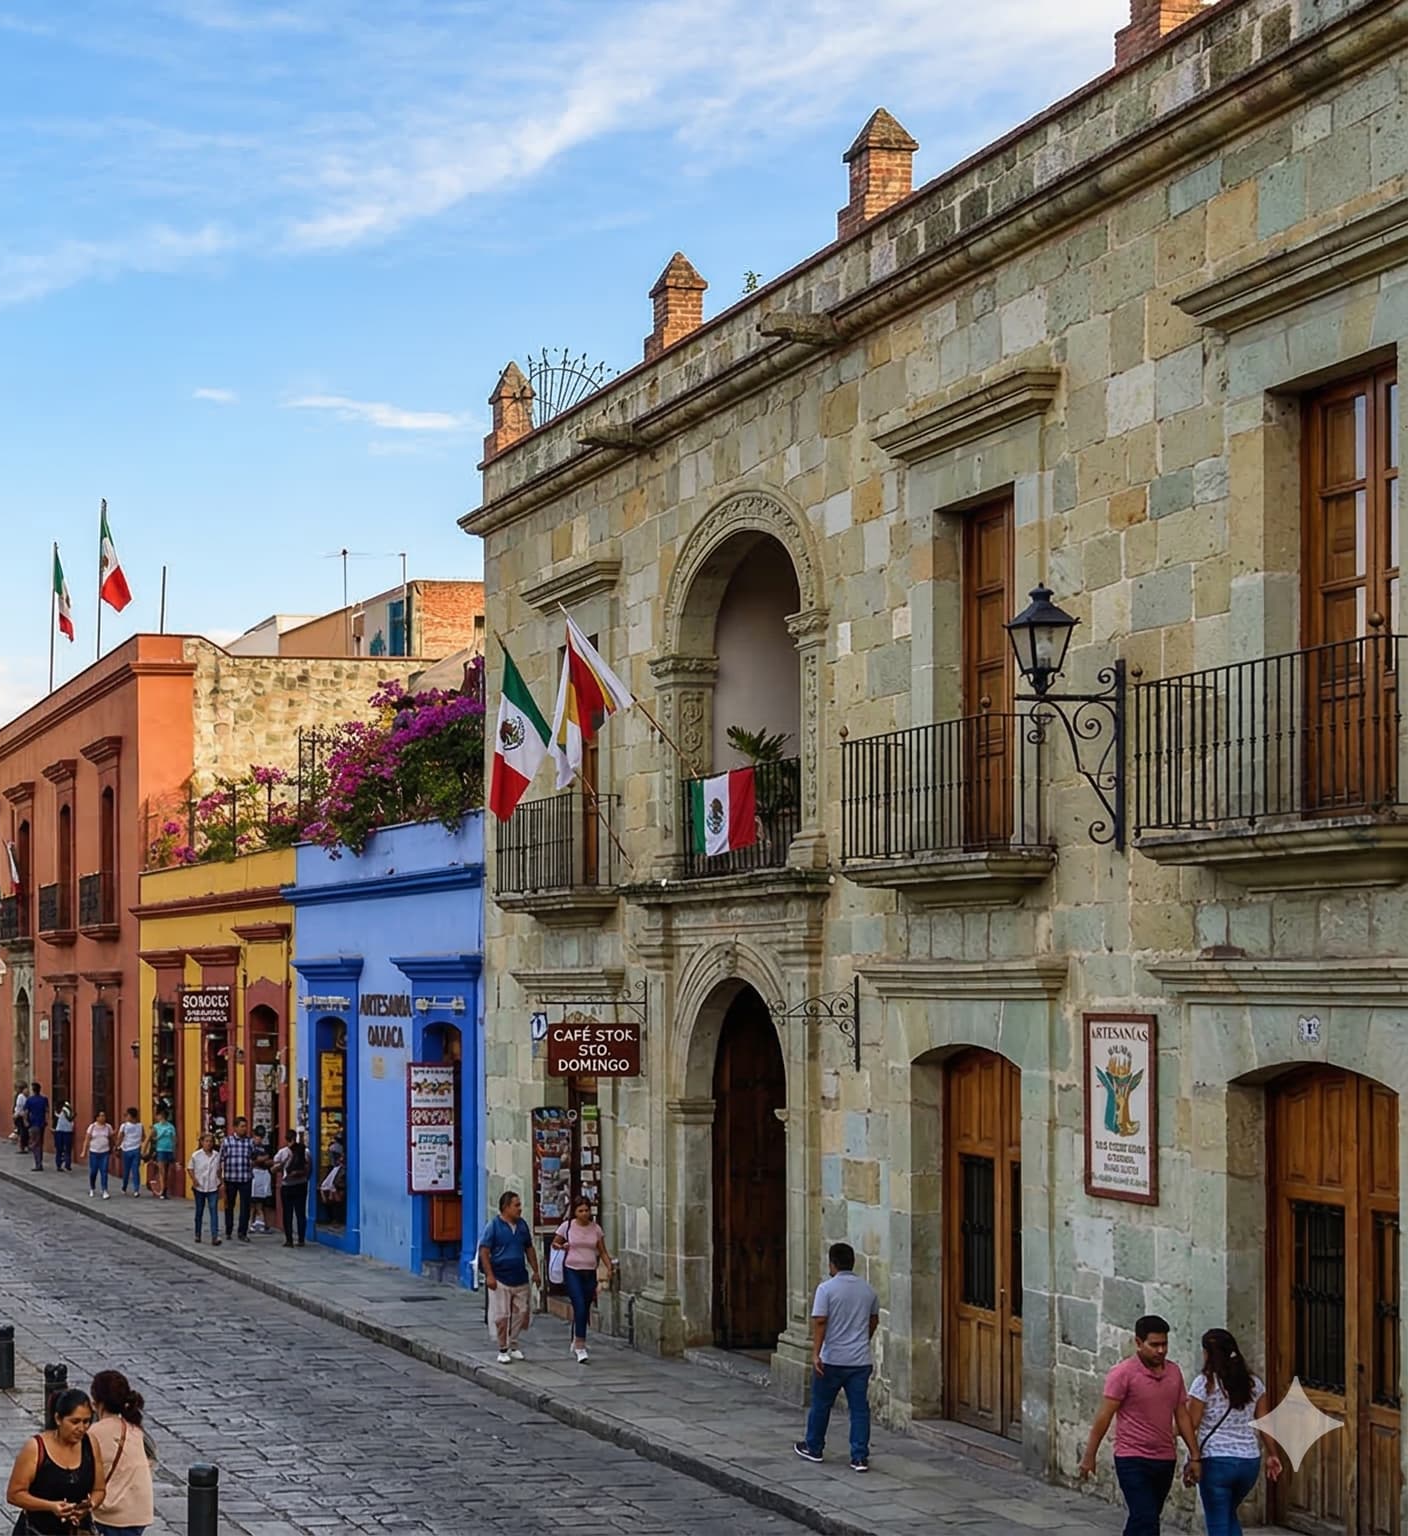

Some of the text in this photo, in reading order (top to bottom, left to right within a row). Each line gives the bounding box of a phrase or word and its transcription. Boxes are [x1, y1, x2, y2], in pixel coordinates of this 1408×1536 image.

[367, 1025, 404, 1048] OAXACA
[554, 1026, 590, 1042] CAFÉ
[558, 1059, 629, 1072] DOMINGO
